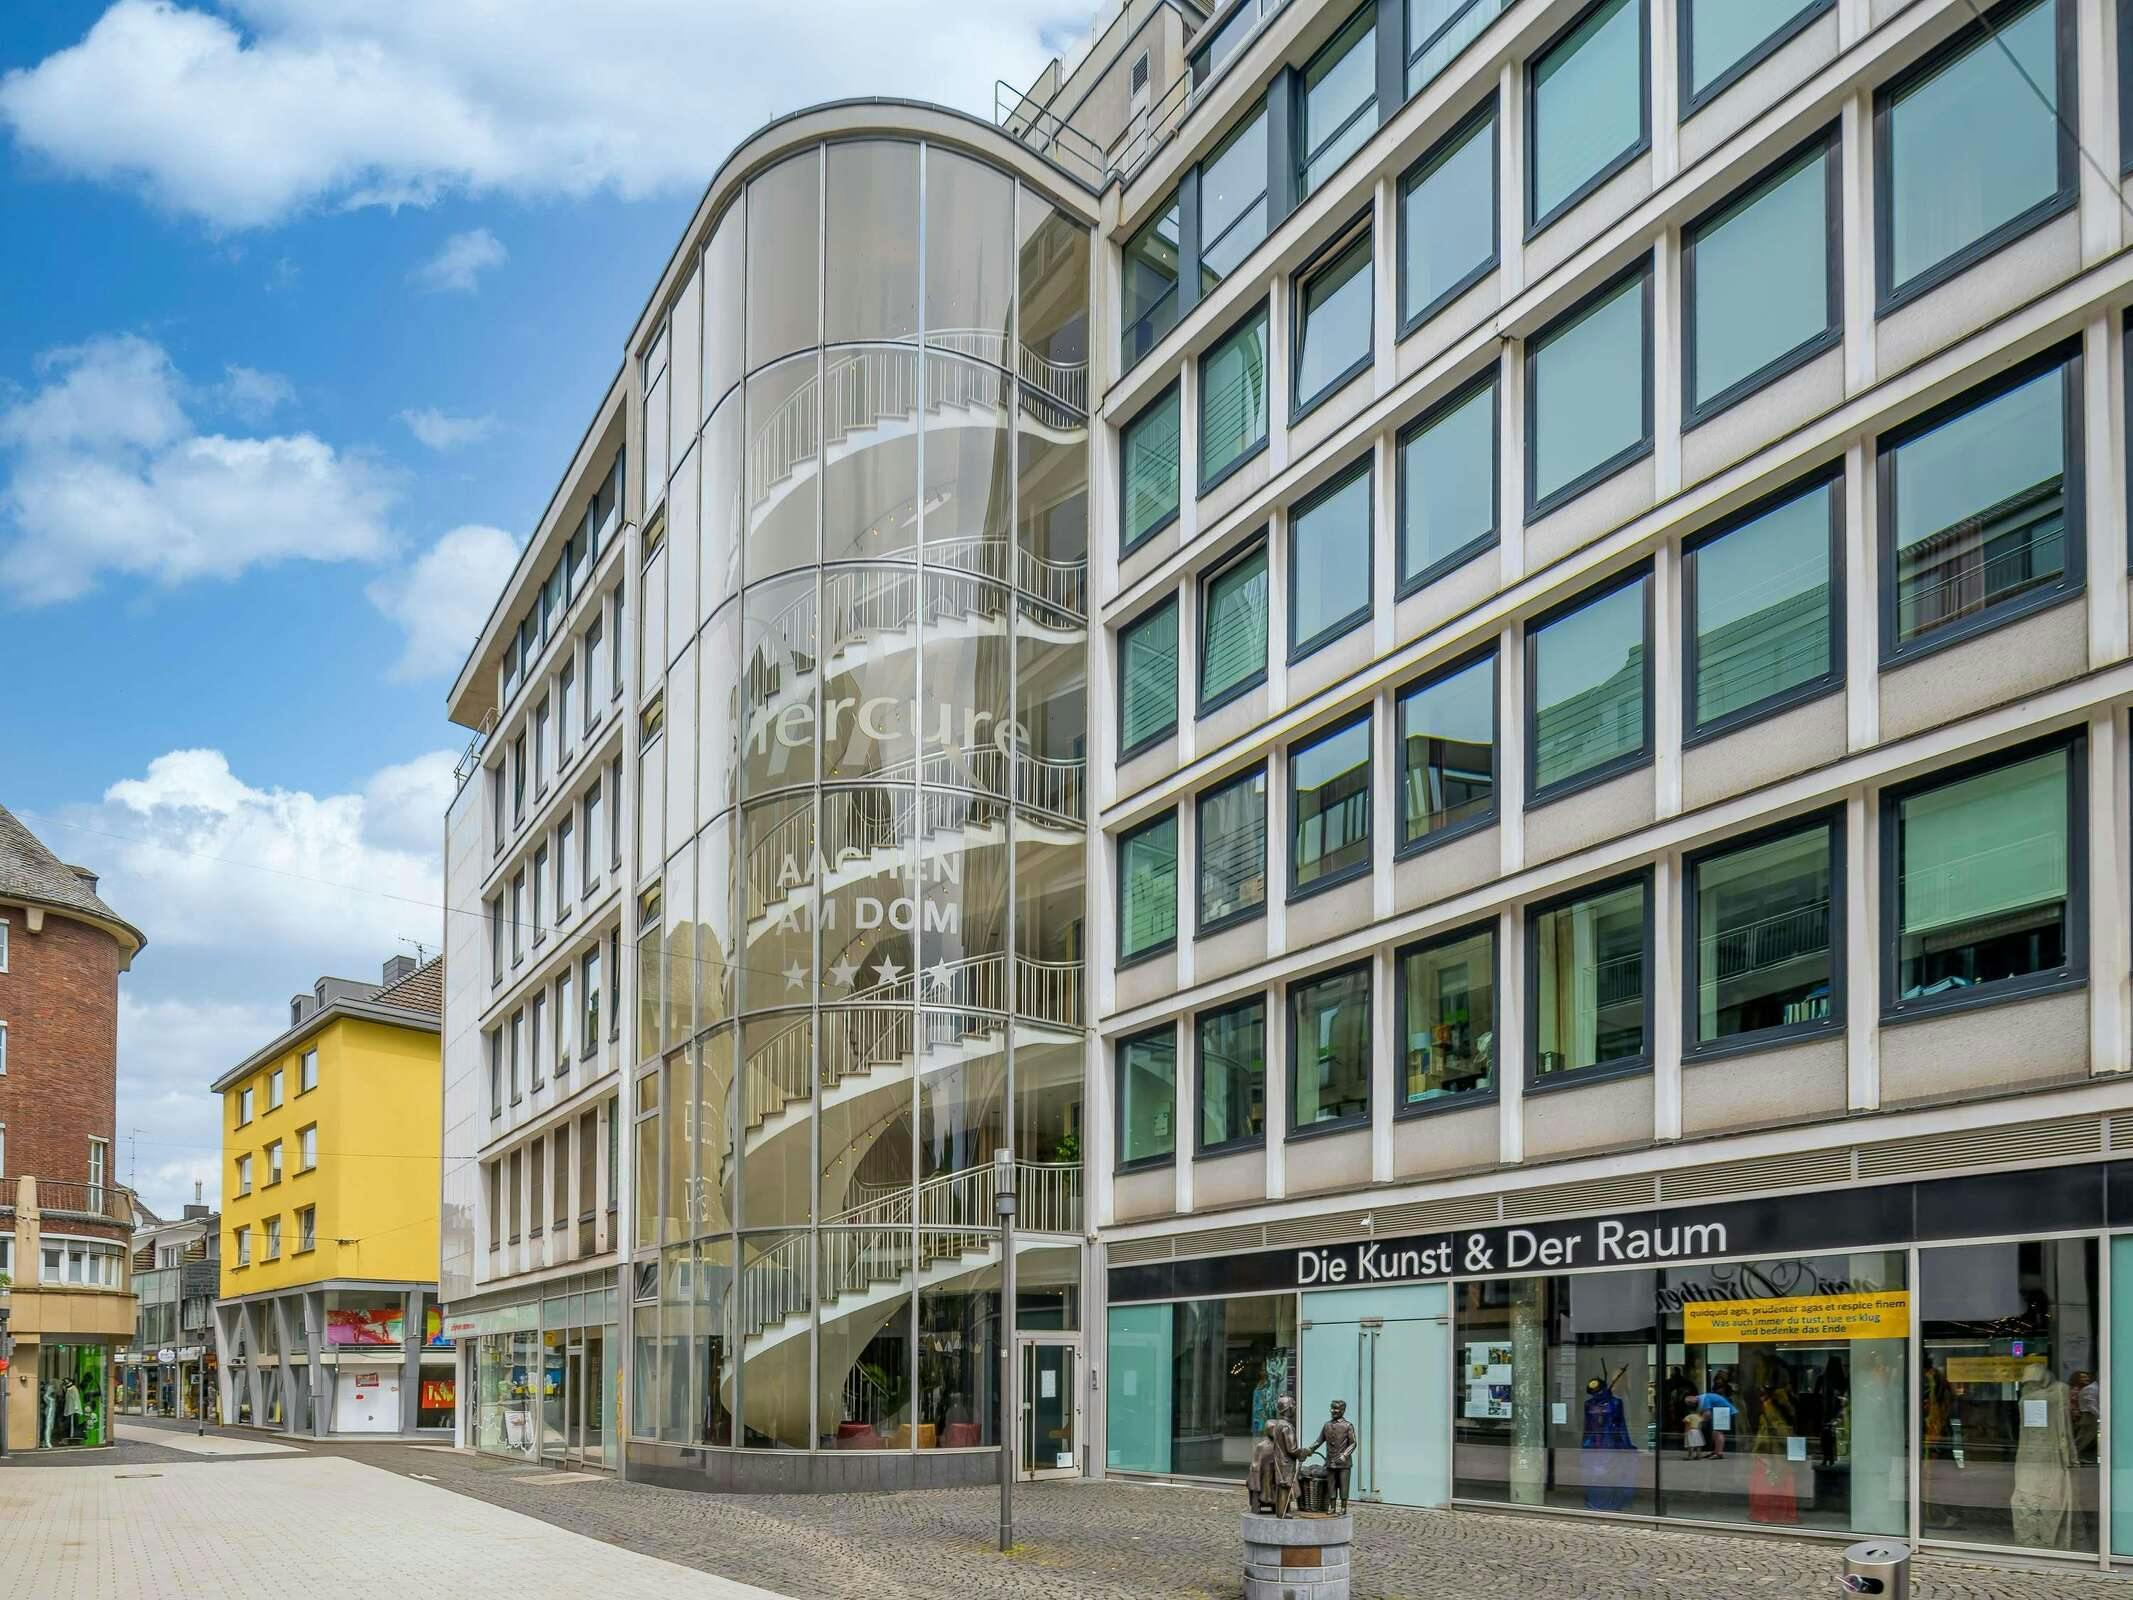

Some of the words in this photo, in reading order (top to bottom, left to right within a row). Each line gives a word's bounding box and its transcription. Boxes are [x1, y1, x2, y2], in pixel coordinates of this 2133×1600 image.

[775, 898, 836, 935] AM
[855, 896, 958, 935] DOM
[1297, 1250, 1347, 1284] Die
[1358, 1239, 1452, 1280] Kunst
[1464, 1233, 1495, 1272] &
[1507, 1229, 1582, 1268] Der
[1598, 1220, 1727, 1261] Raum
[1690, 1308, 1729, 1318] quidquid
[1752, 1304, 1798, 1316] prudenter
[1801, 1303, 1823, 1313] agas
[1825, 1303, 1835, 1311] et
[1838, 1301, 1873, 1311] respice
[1875, 1299, 1906, 1309] finem
[1711, 1319, 1730, 1328] Was
[1730, 1318, 1753, 1327] auch
[1755, 1317, 1785, 1326] immer
[1786, 1316, 1799, 1325] du
[1826, 1315, 1842, 1323] tue
[1846, 1315, 1857, 1323] es
[1859, 1312, 1881, 1324] klug
[1740, 1327, 1759, 1336] und
[1760, 1325, 1800, 1335] bedenke
[1802, 1324, 1819, 1334] das
[1822, 1324, 1847, 1333] Ende
